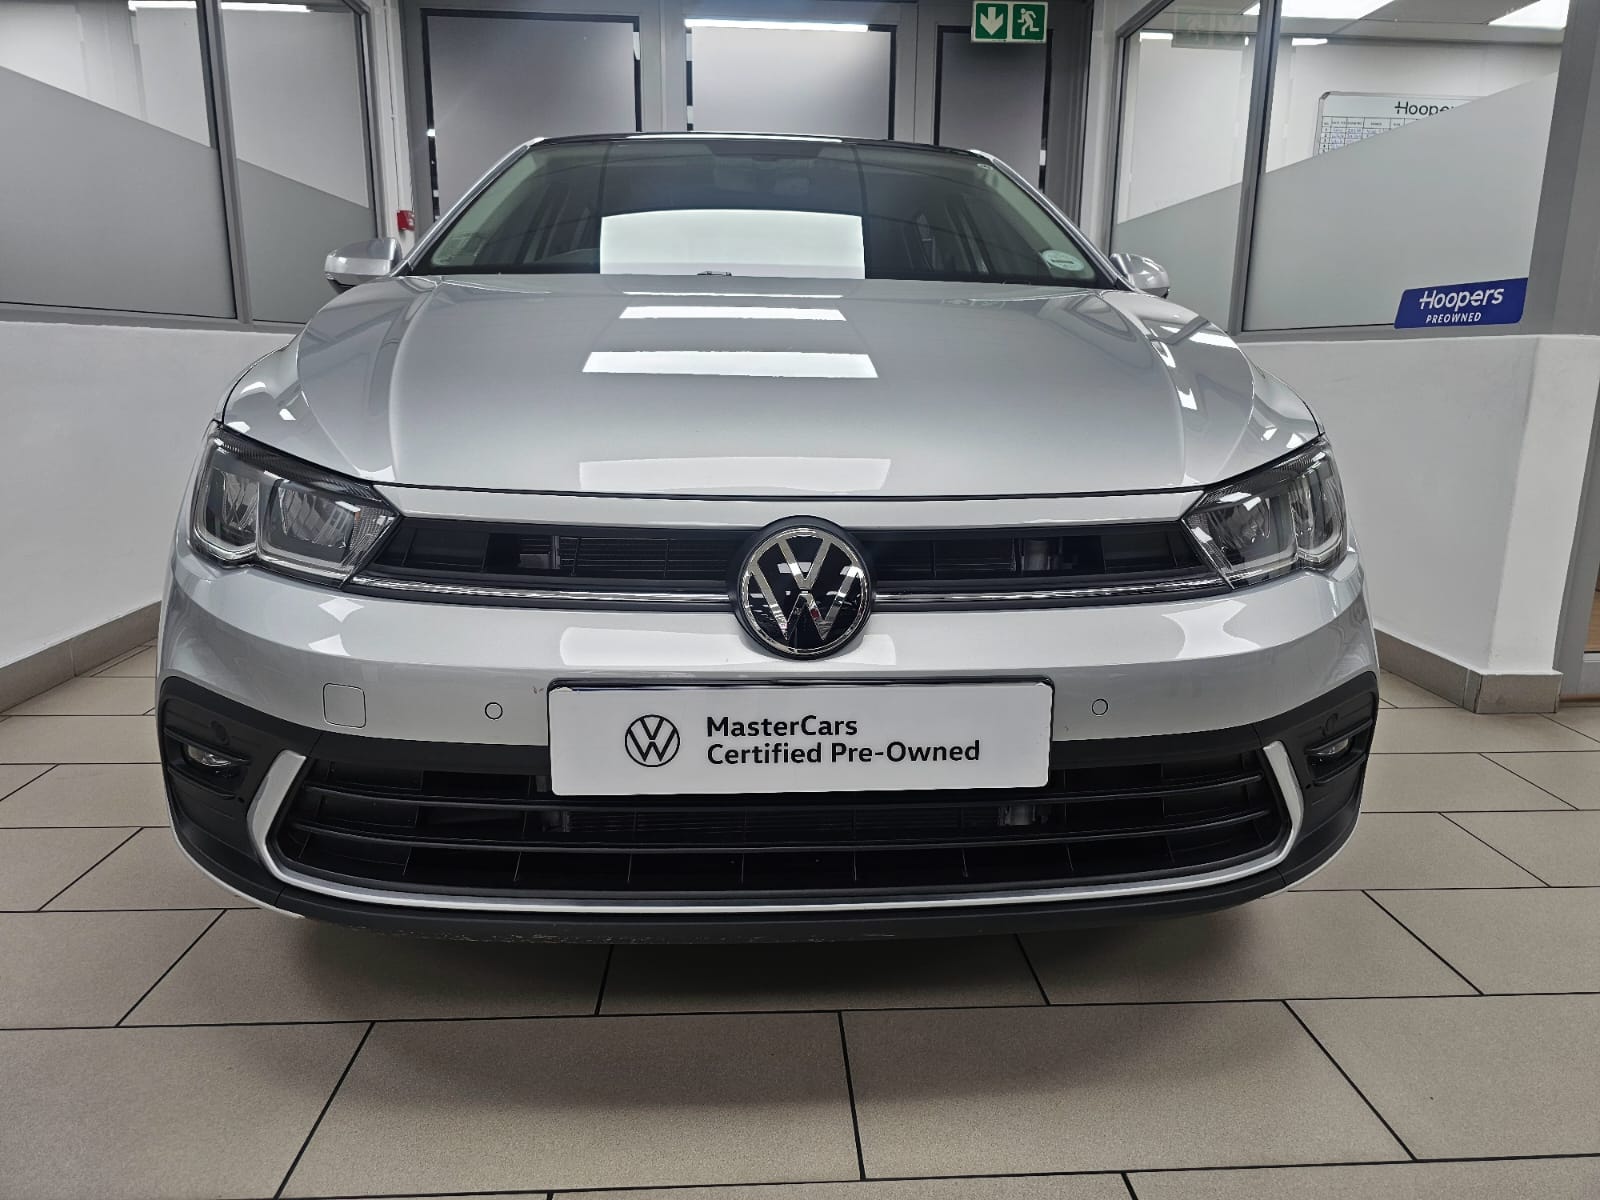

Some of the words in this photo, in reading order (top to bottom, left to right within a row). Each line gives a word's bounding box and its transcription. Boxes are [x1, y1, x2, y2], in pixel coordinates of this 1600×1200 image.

[1419, 288, 1505, 312] Hoopers
[1425, 312, 1481, 324] PREOWNED
[706, 714, 859, 738] MasterCars
[706, 742, 823, 765] Certified
[831, 739, 980, 763] Pre-Owned
